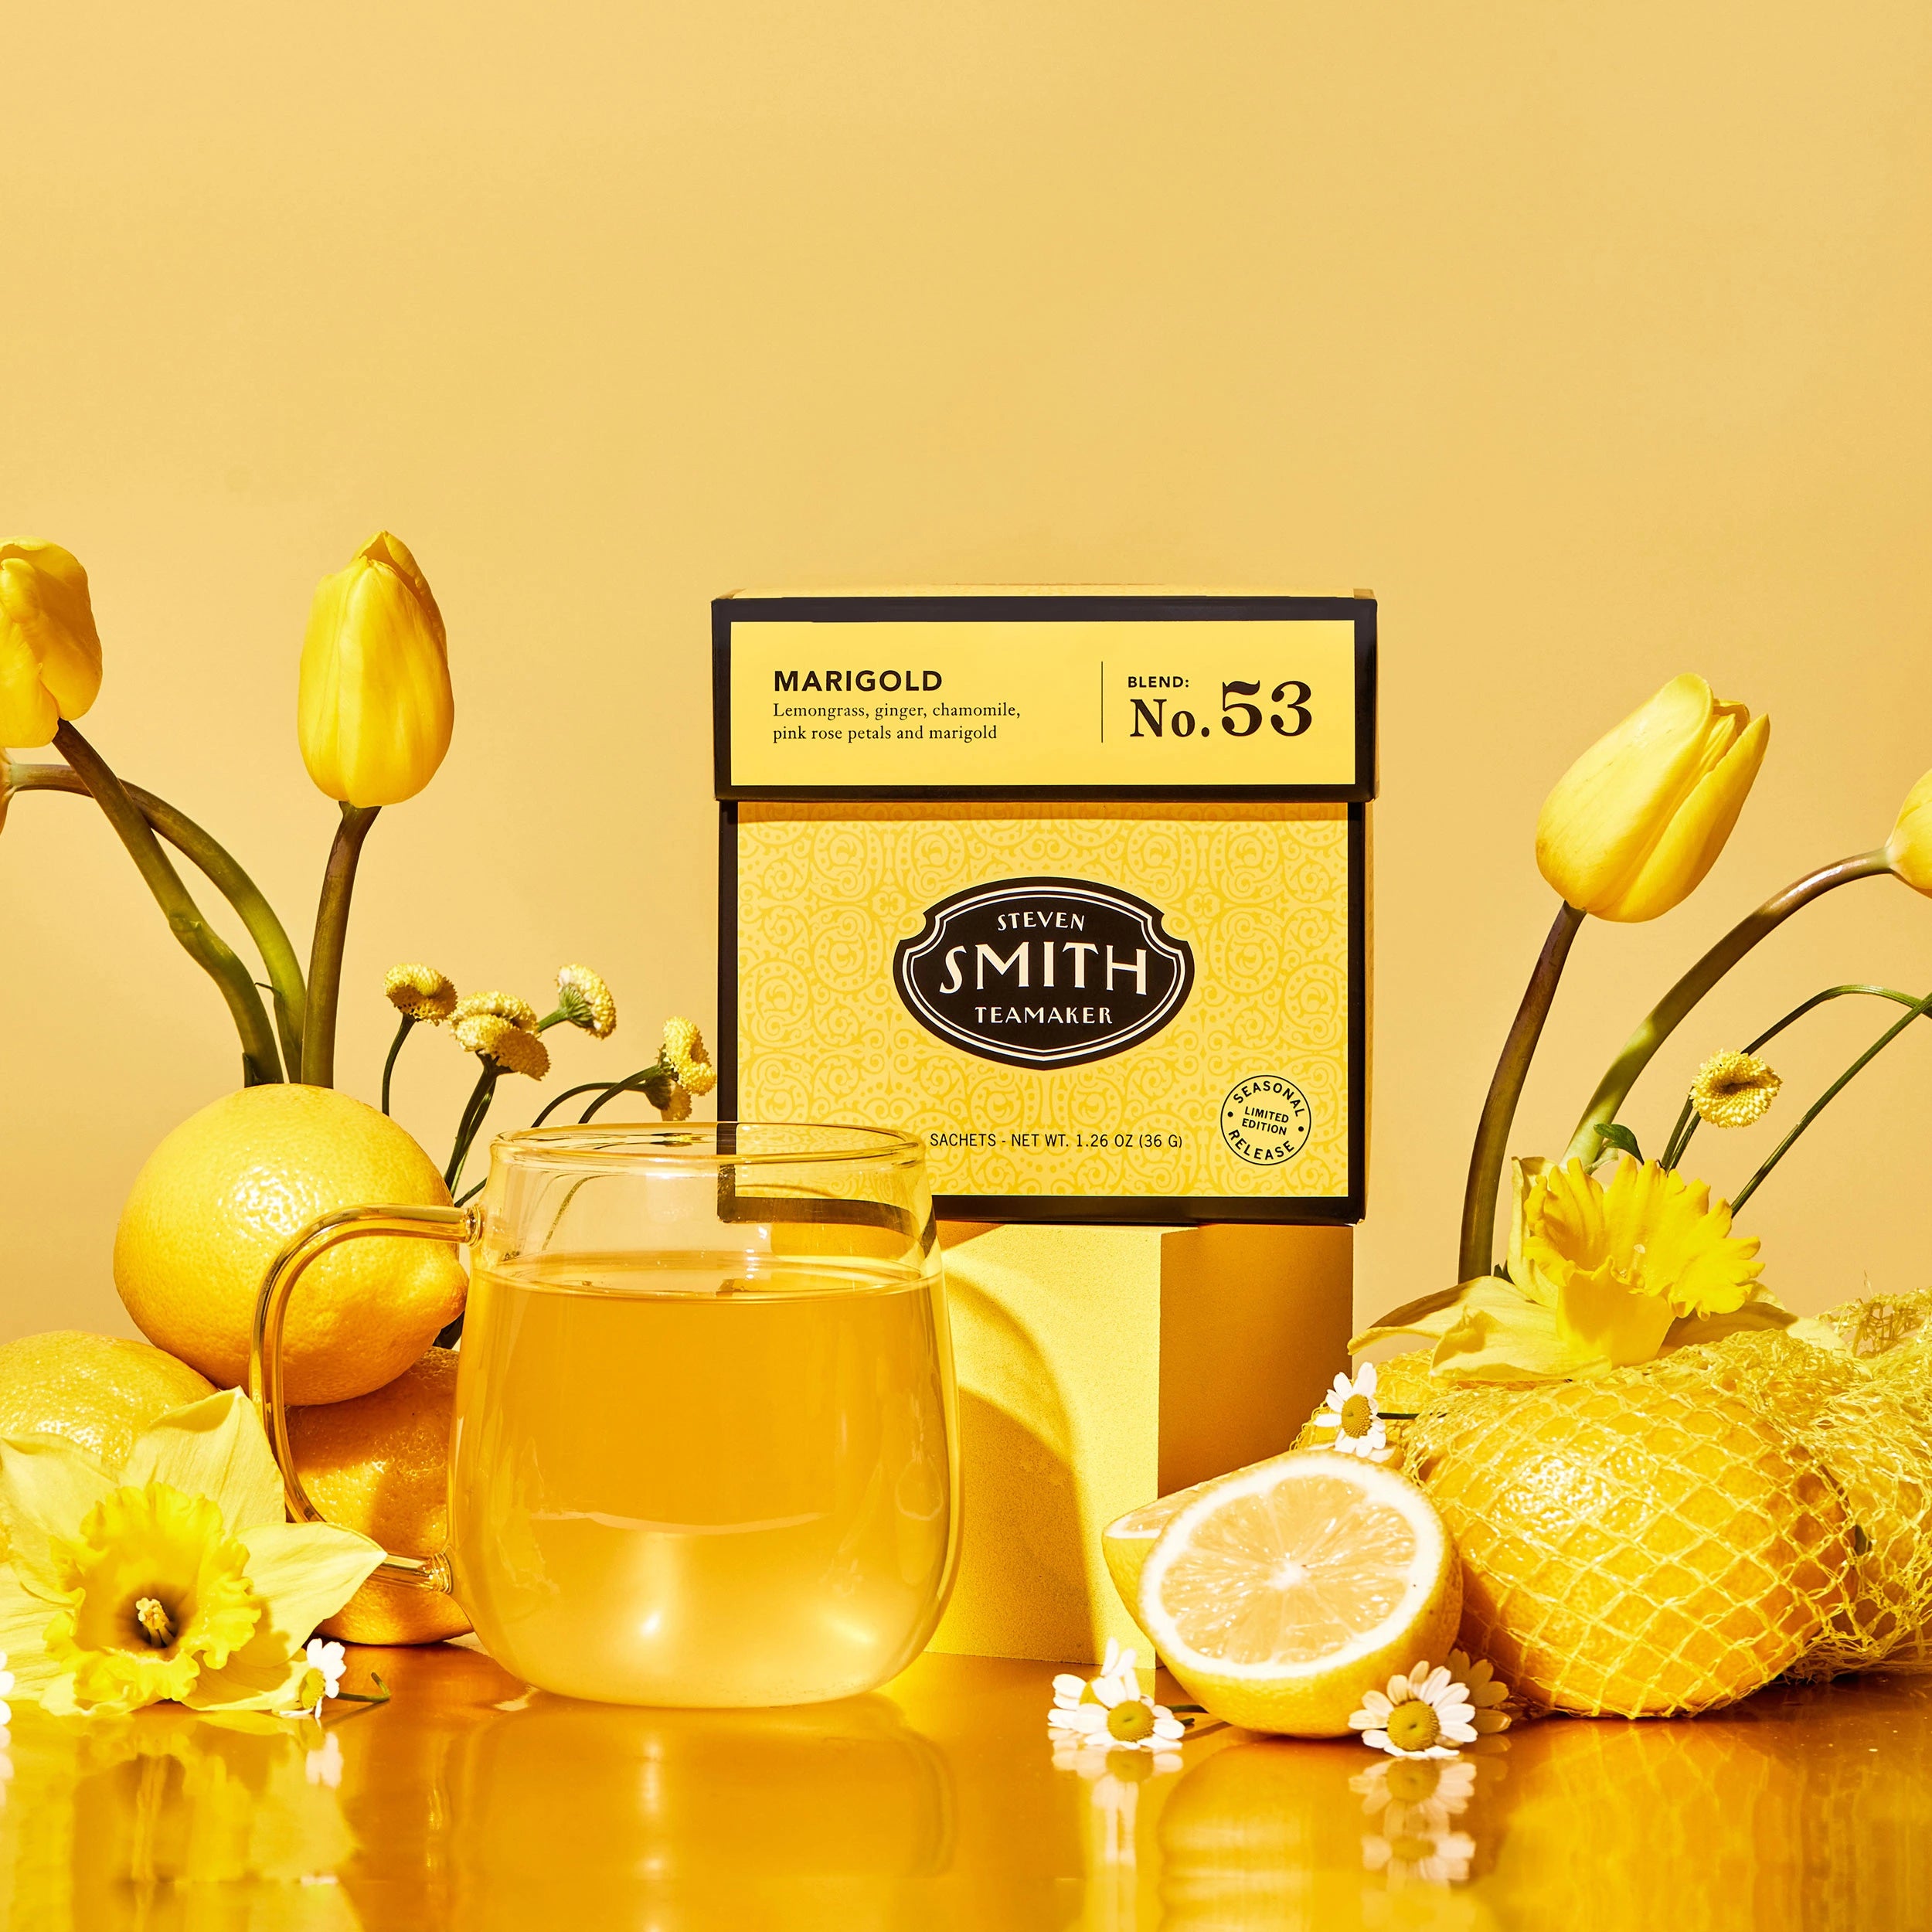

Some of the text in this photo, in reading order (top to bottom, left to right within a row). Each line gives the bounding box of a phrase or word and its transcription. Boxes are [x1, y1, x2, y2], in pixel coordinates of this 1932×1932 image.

[774, 669, 943, 692] MARIGOLD
[1128, 675, 1190, 689] BLEND:
[774, 702, 1021, 721] Lemongrass, ginger, chamomile,
[773, 725, 997, 743] pink rose petals and marigold
[997, 910, 1085, 931] STEVEN
[939, 940, 1148, 995] SMITH
[974, 1006, 1113, 1025] TEAMAKER
[1233, 1080, 1305, 1117] SEASONAL
[1244, 1106, 1289, 1123] LIMITED
[1241, 1117, 1287, 1136] EDITION
[930, 1133, 997, 1147] SACHETS
[1012, 1133, 1040, 1147] NET
[1044, 1133, 1071, 1148] WT.
[1076, 1134, 1109, 1148] 1.26
[1114, 1134, 1134, 1148] OZ
[1138, 1133, 1163, 1148] (36
[1168, 1133, 1183, 1149] G)
[1228, 1129, 1295, 1161] RELEASE
